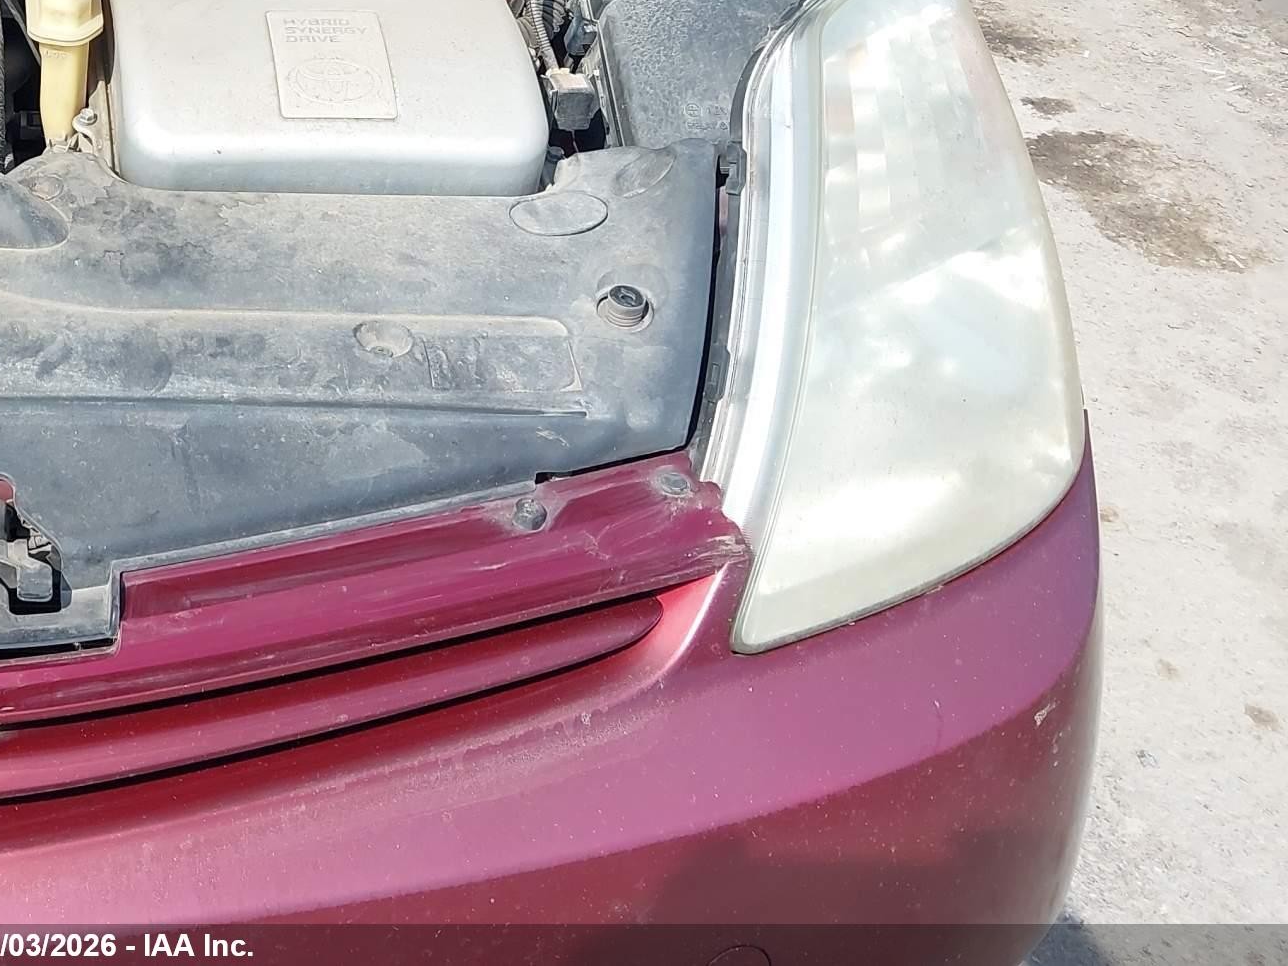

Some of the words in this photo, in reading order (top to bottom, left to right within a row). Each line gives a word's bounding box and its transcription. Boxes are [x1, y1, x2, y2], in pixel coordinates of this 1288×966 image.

[282, 18, 350, 26] HYBRID
[284, 26, 368, 35] SYNERGY
[285, 35, 341, 43] DRIVE
